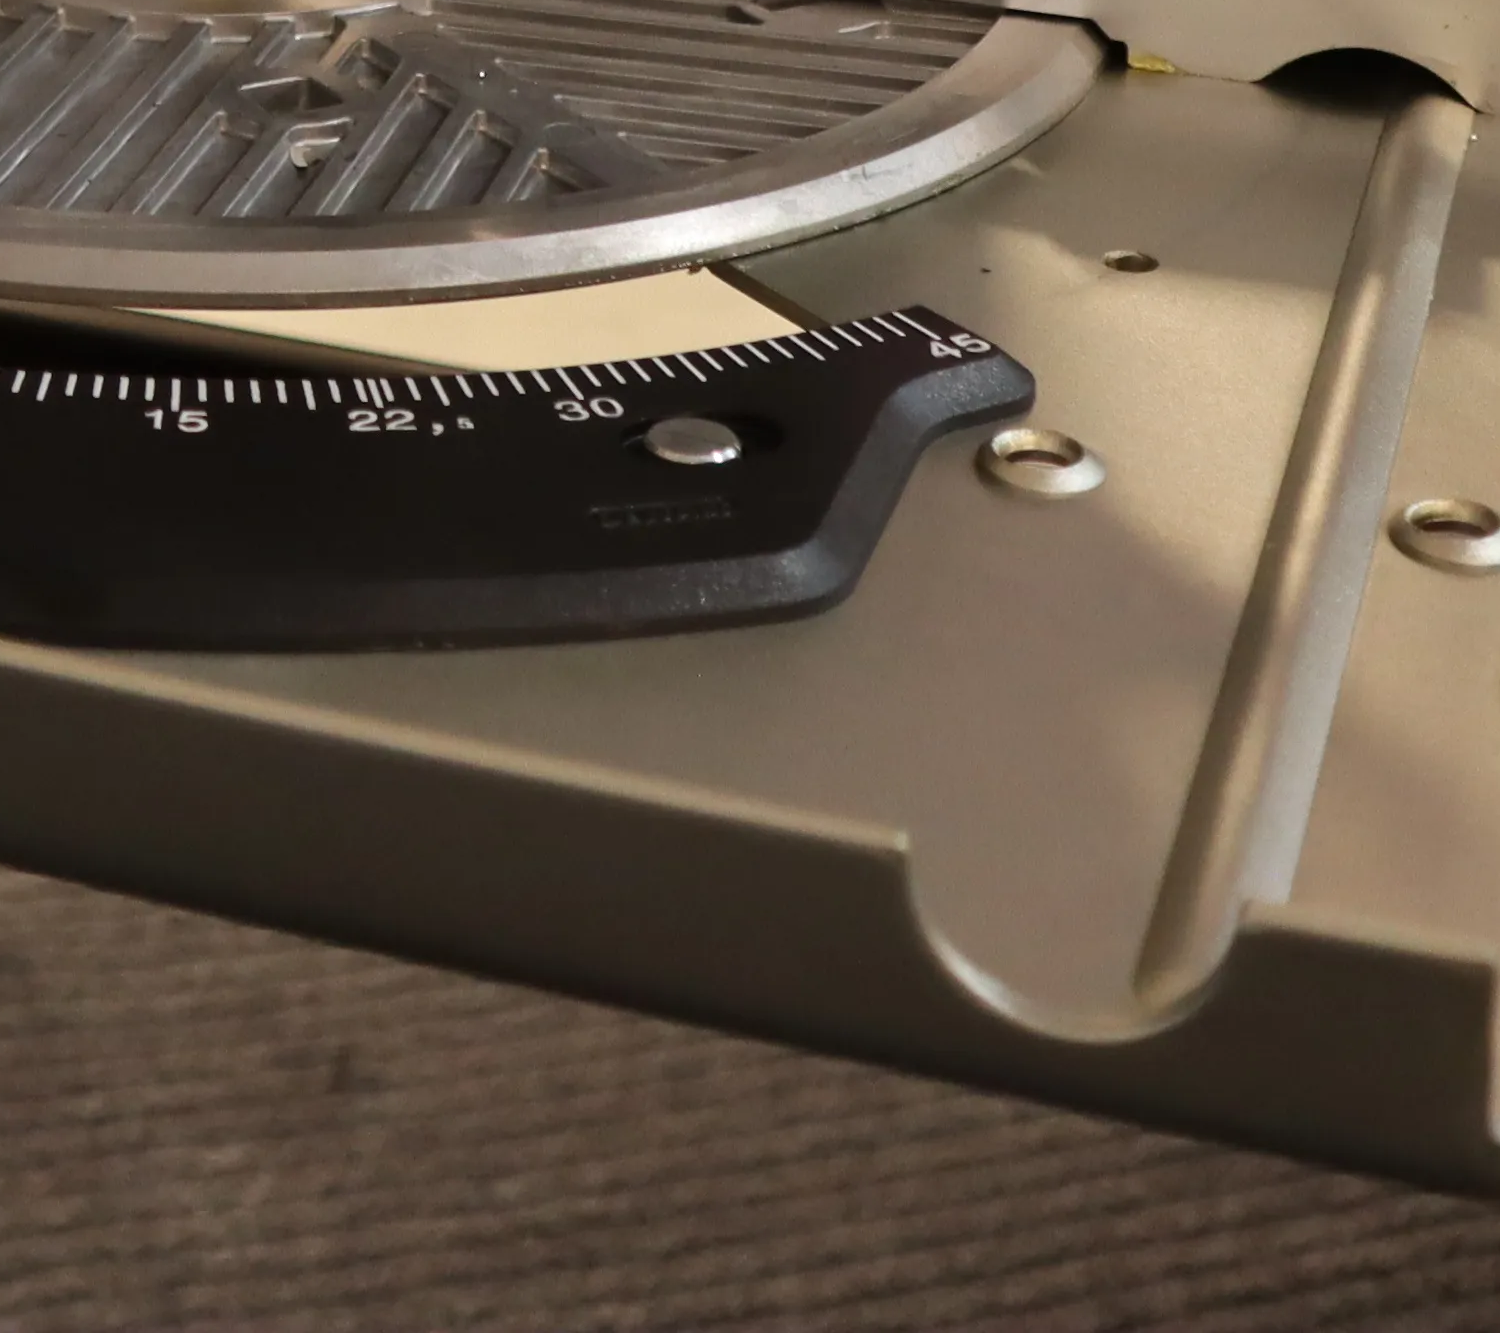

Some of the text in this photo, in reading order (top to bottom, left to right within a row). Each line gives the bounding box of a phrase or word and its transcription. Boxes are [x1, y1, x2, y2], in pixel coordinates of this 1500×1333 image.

[929, 333, 993, 360] 45
[144, 408, 209, 433] 15
[553, 396, 625, 423] 30
